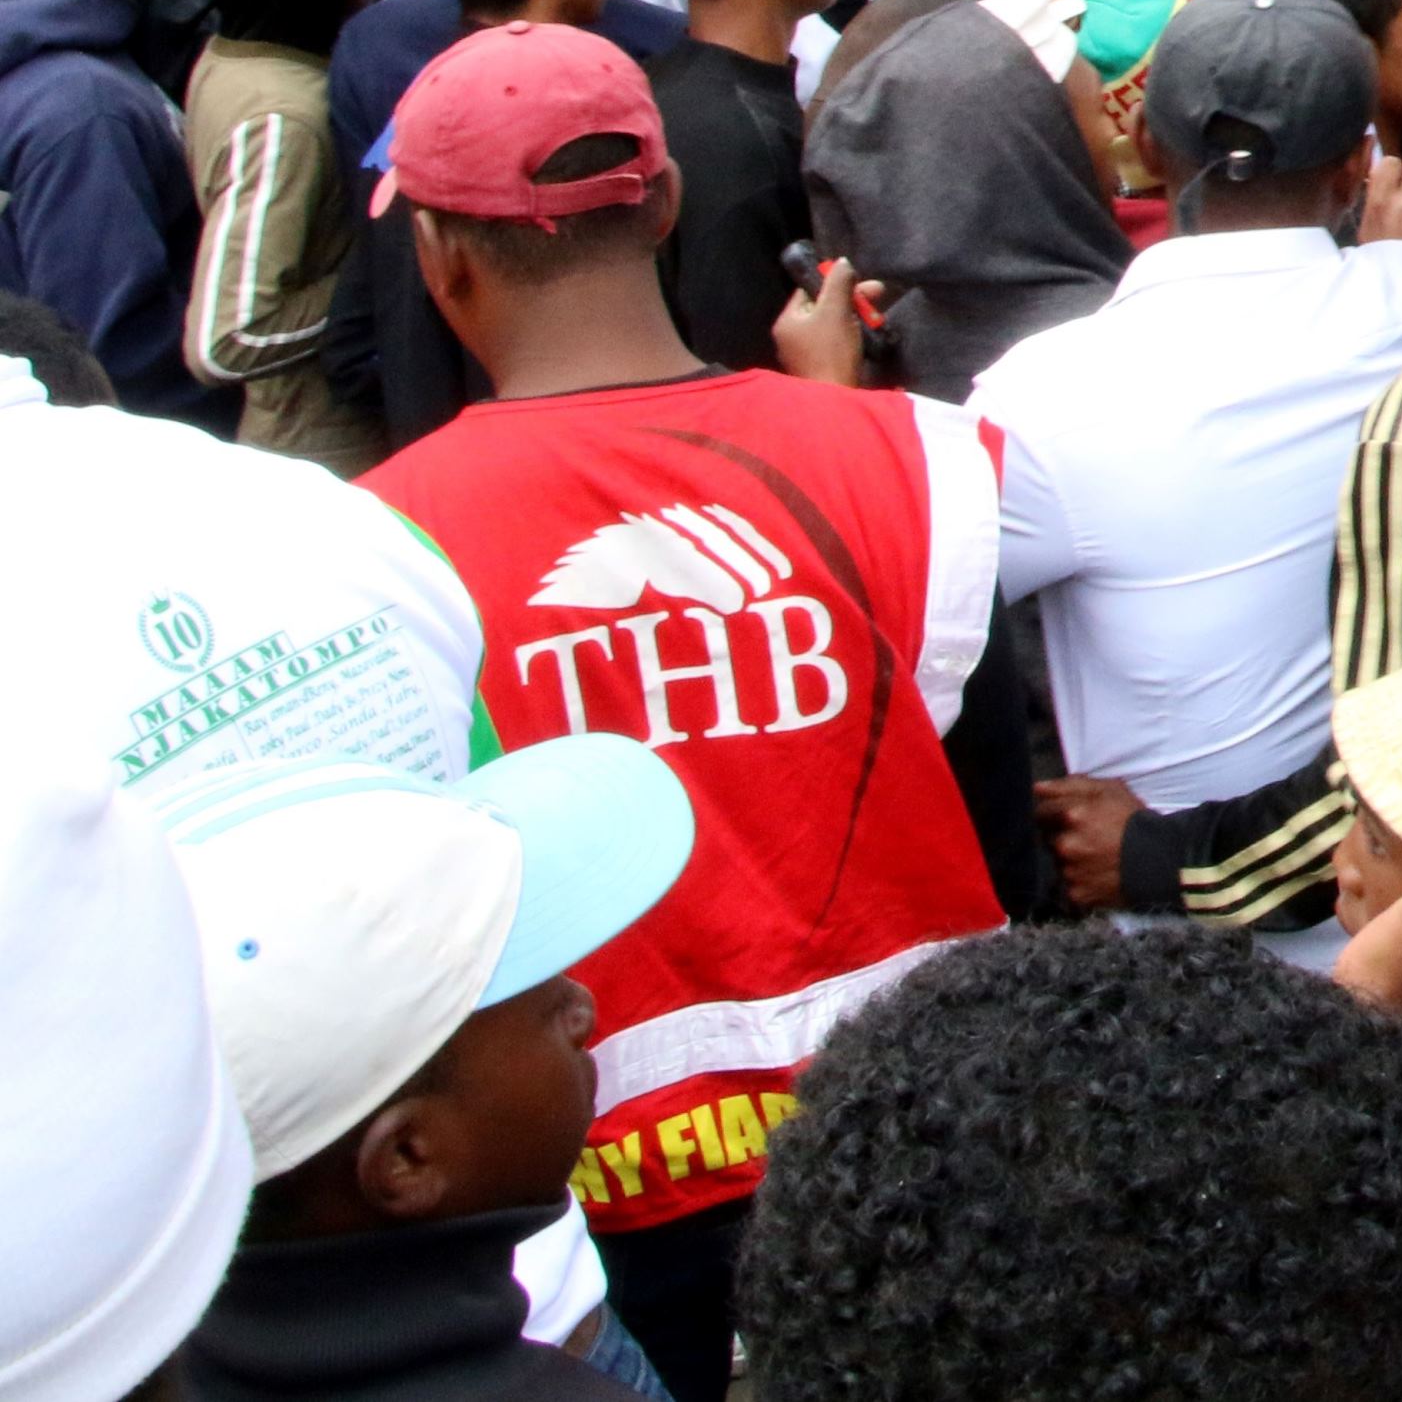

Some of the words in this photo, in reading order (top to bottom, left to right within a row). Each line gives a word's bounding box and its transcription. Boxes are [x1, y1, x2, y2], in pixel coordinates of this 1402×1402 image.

[120, 614, 389, 780] NJAKATOMPO
[140, 636, 286, 730] MAAAM
[154, 610, 203, 661] 10
[515, 595, 849, 749] THB
